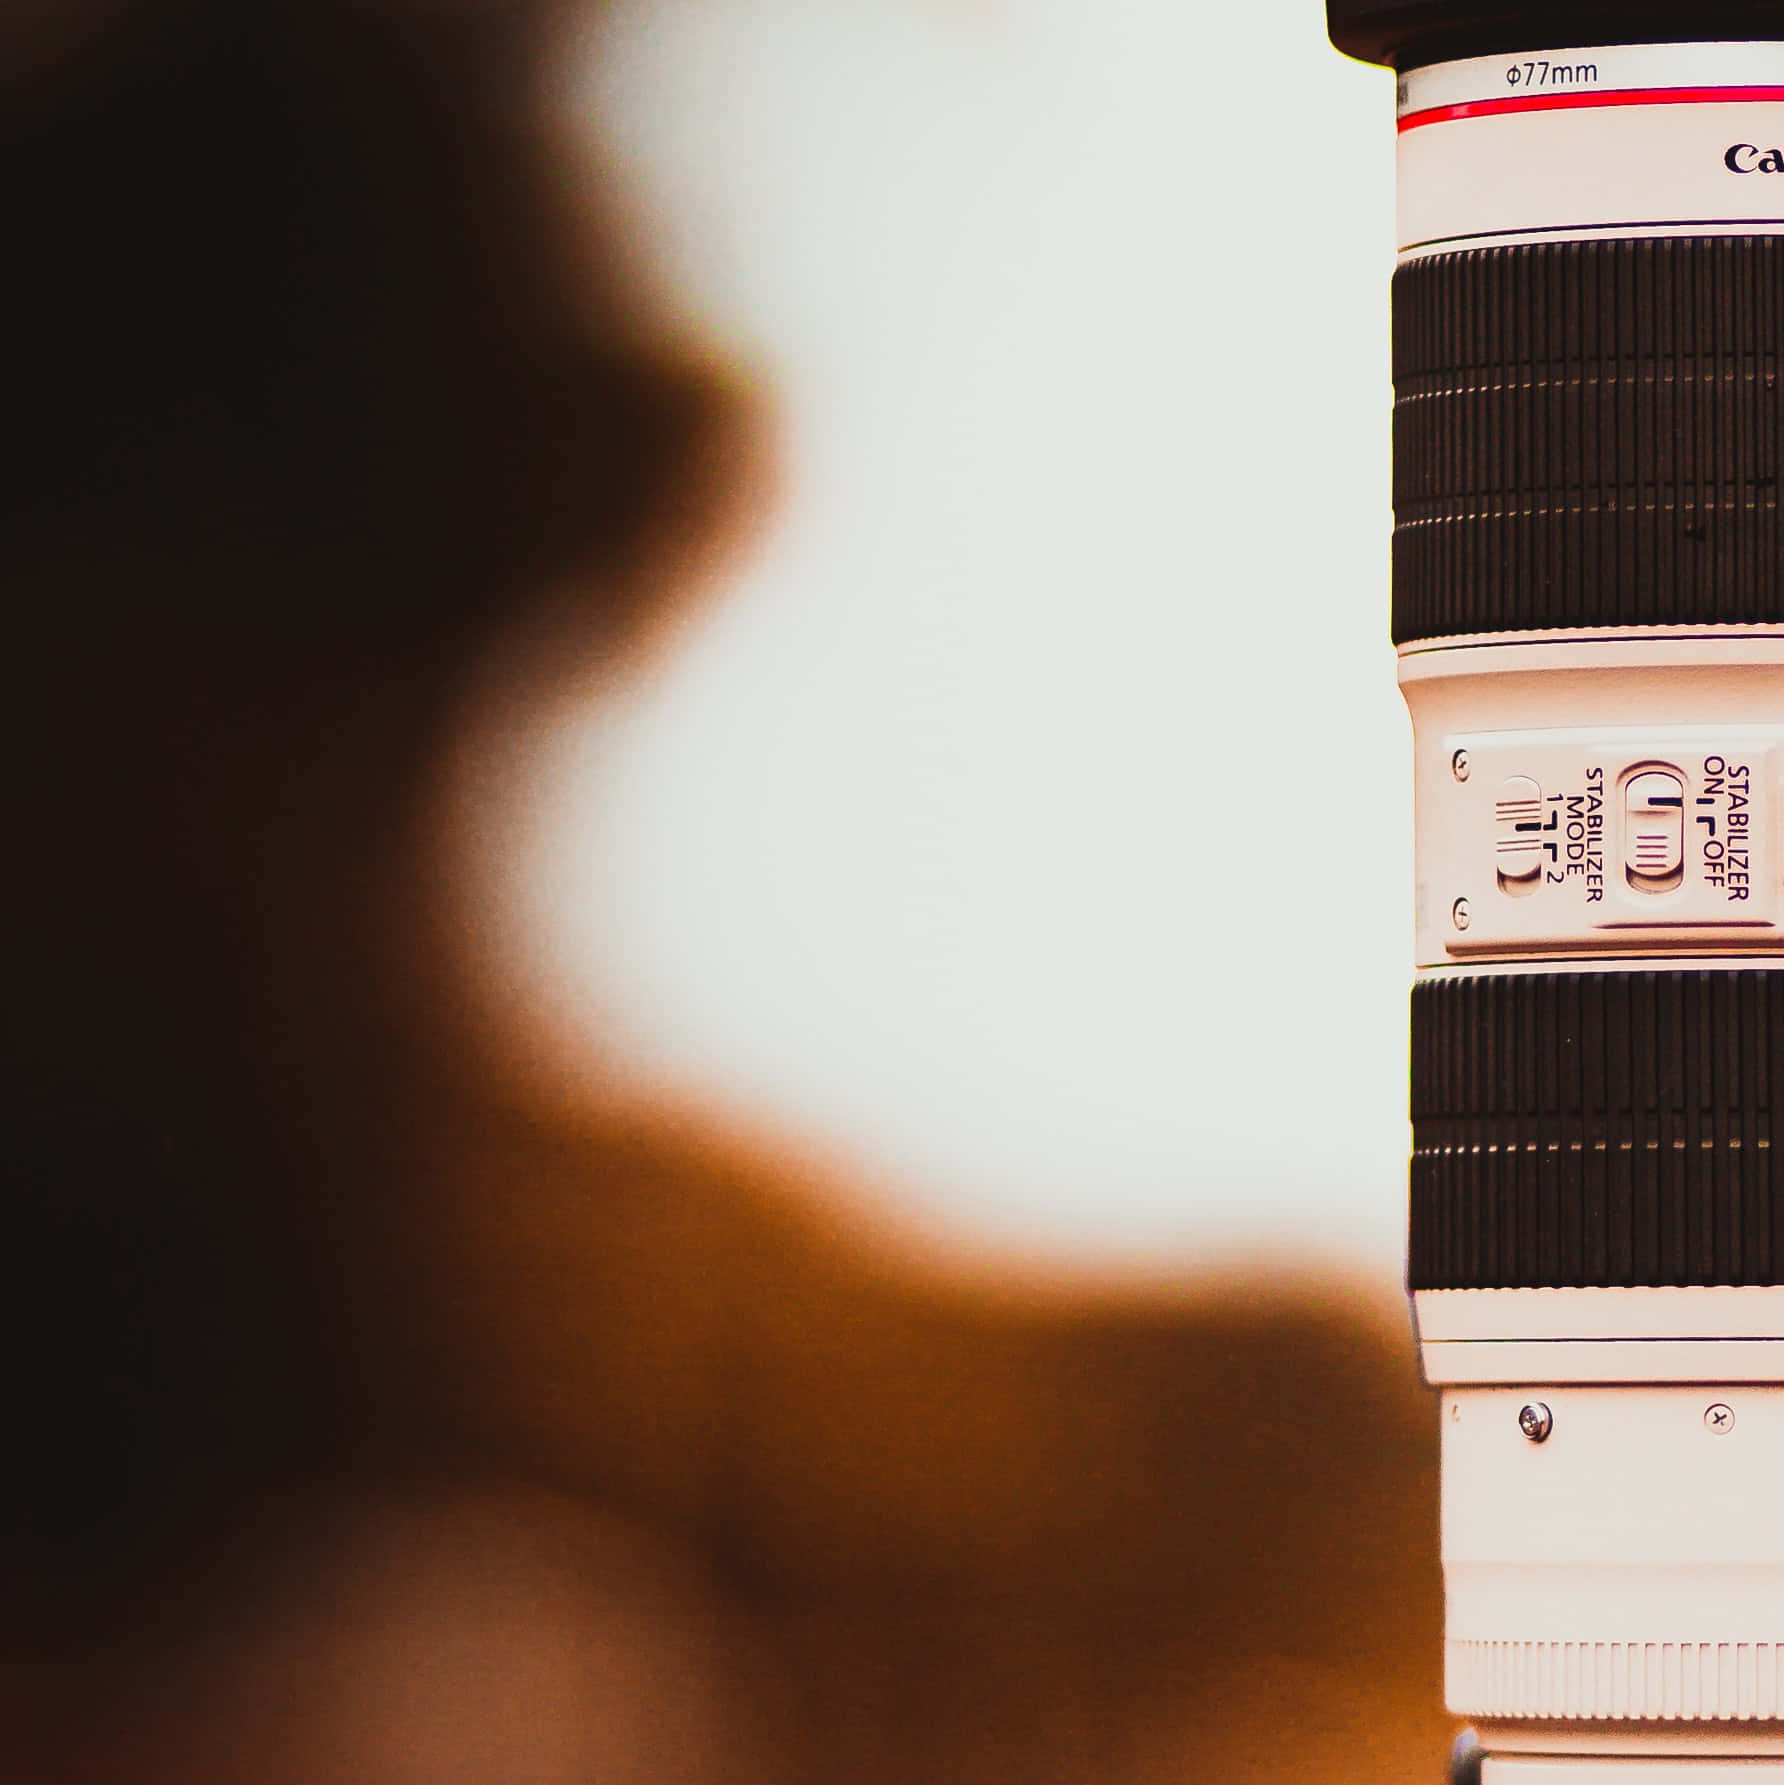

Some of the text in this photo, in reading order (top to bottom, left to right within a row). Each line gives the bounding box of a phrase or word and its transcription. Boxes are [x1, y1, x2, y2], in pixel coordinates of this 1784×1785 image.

[1703, 755, 1725, 795] ON
[1566, 796, 1585, 876] MODE
[1586, 767, 1604, 903] STABILIZER
[1703, 840, 1725, 888] OFF
[1727, 765, 1750, 901] STABILIZER
[1546, 871, 1565, 884] 2
